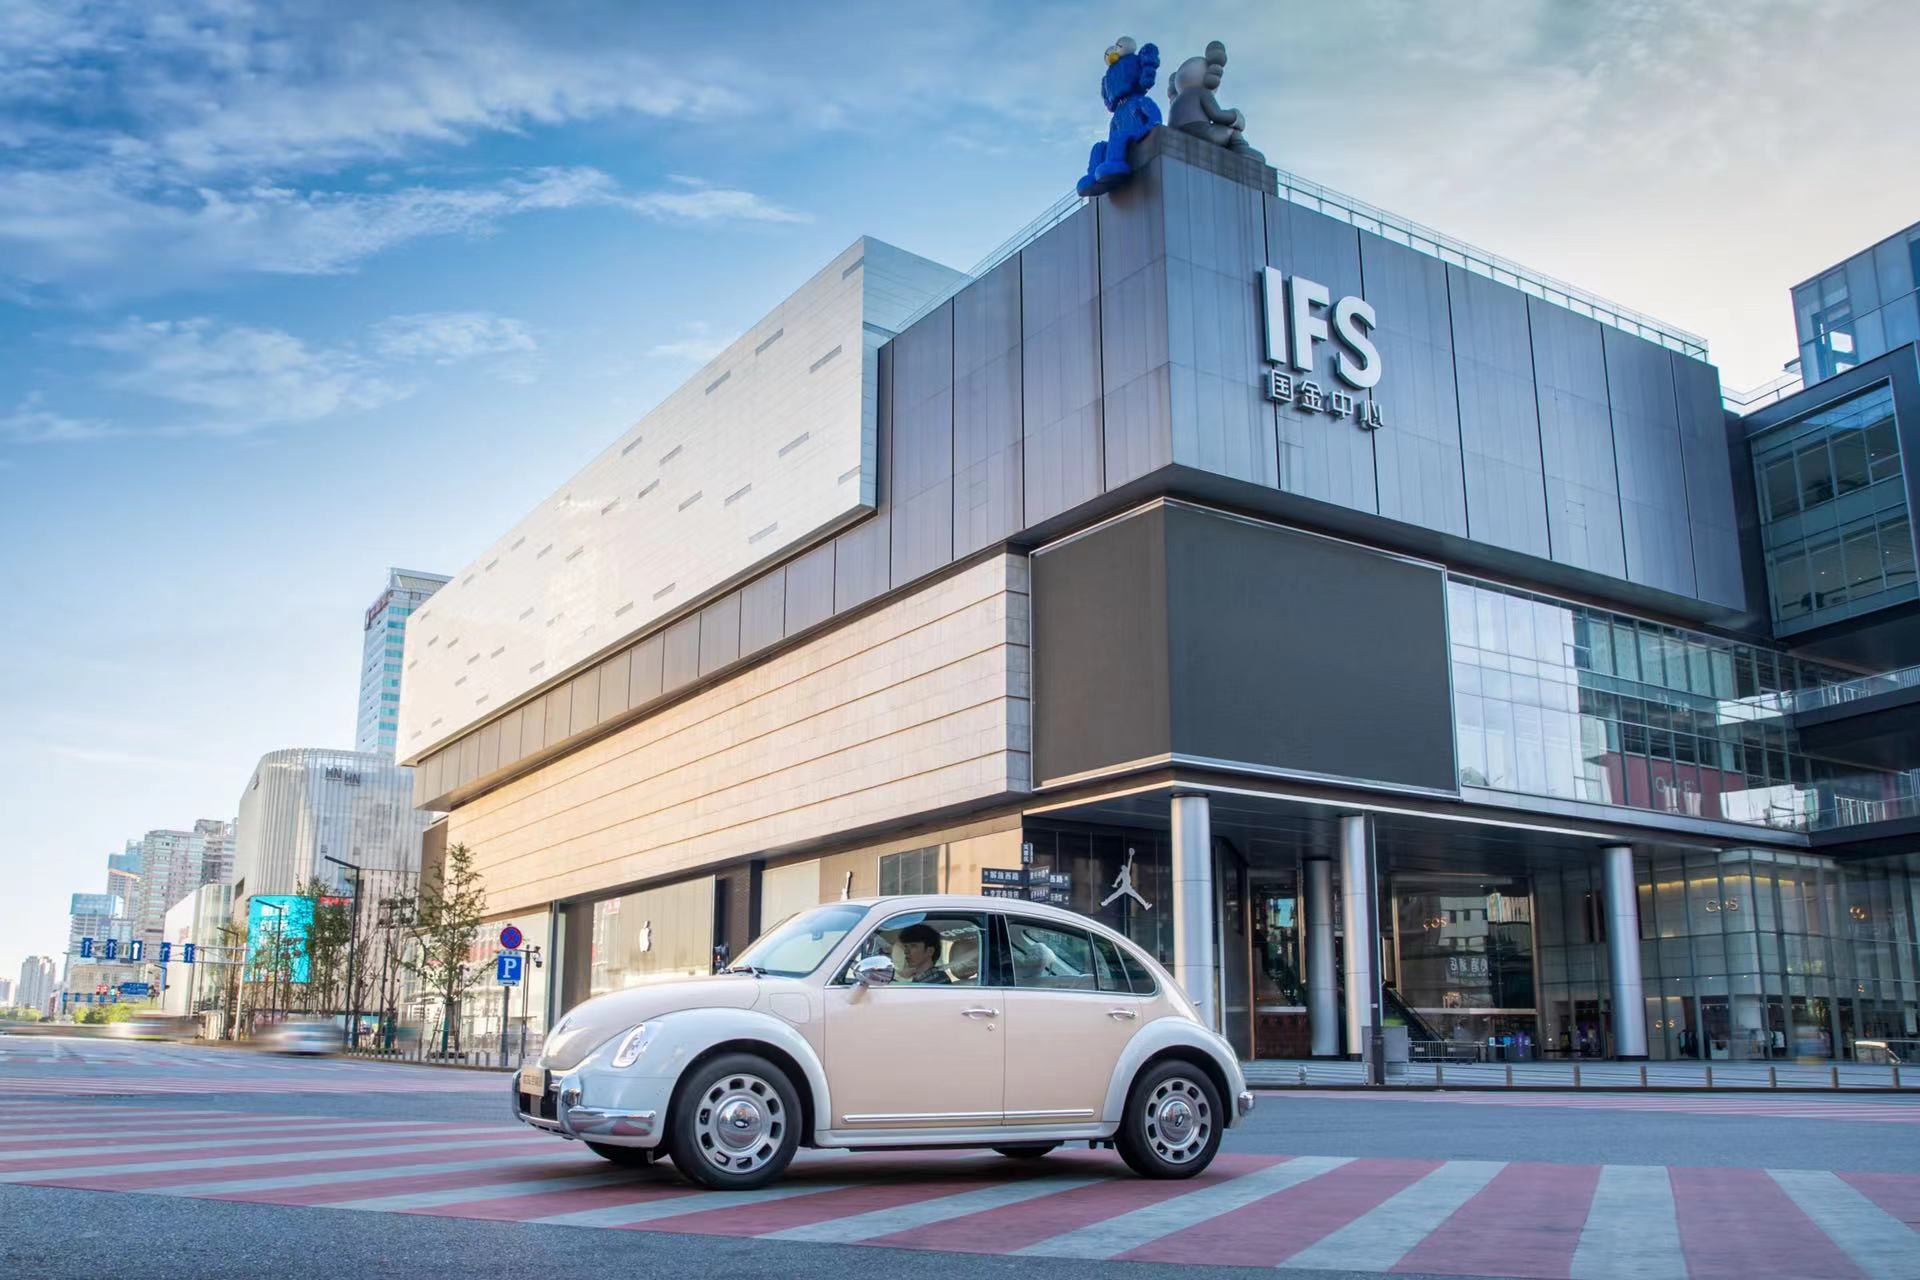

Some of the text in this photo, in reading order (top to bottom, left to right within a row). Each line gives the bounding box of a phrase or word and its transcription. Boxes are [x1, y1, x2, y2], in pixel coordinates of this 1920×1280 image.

[1262, 266, 1382, 389] IFS
[1267, 369, 1384, 429] 国金中心
[503, 958, 517, 978] P
[1655, 1018, 1675, 1029] CS
